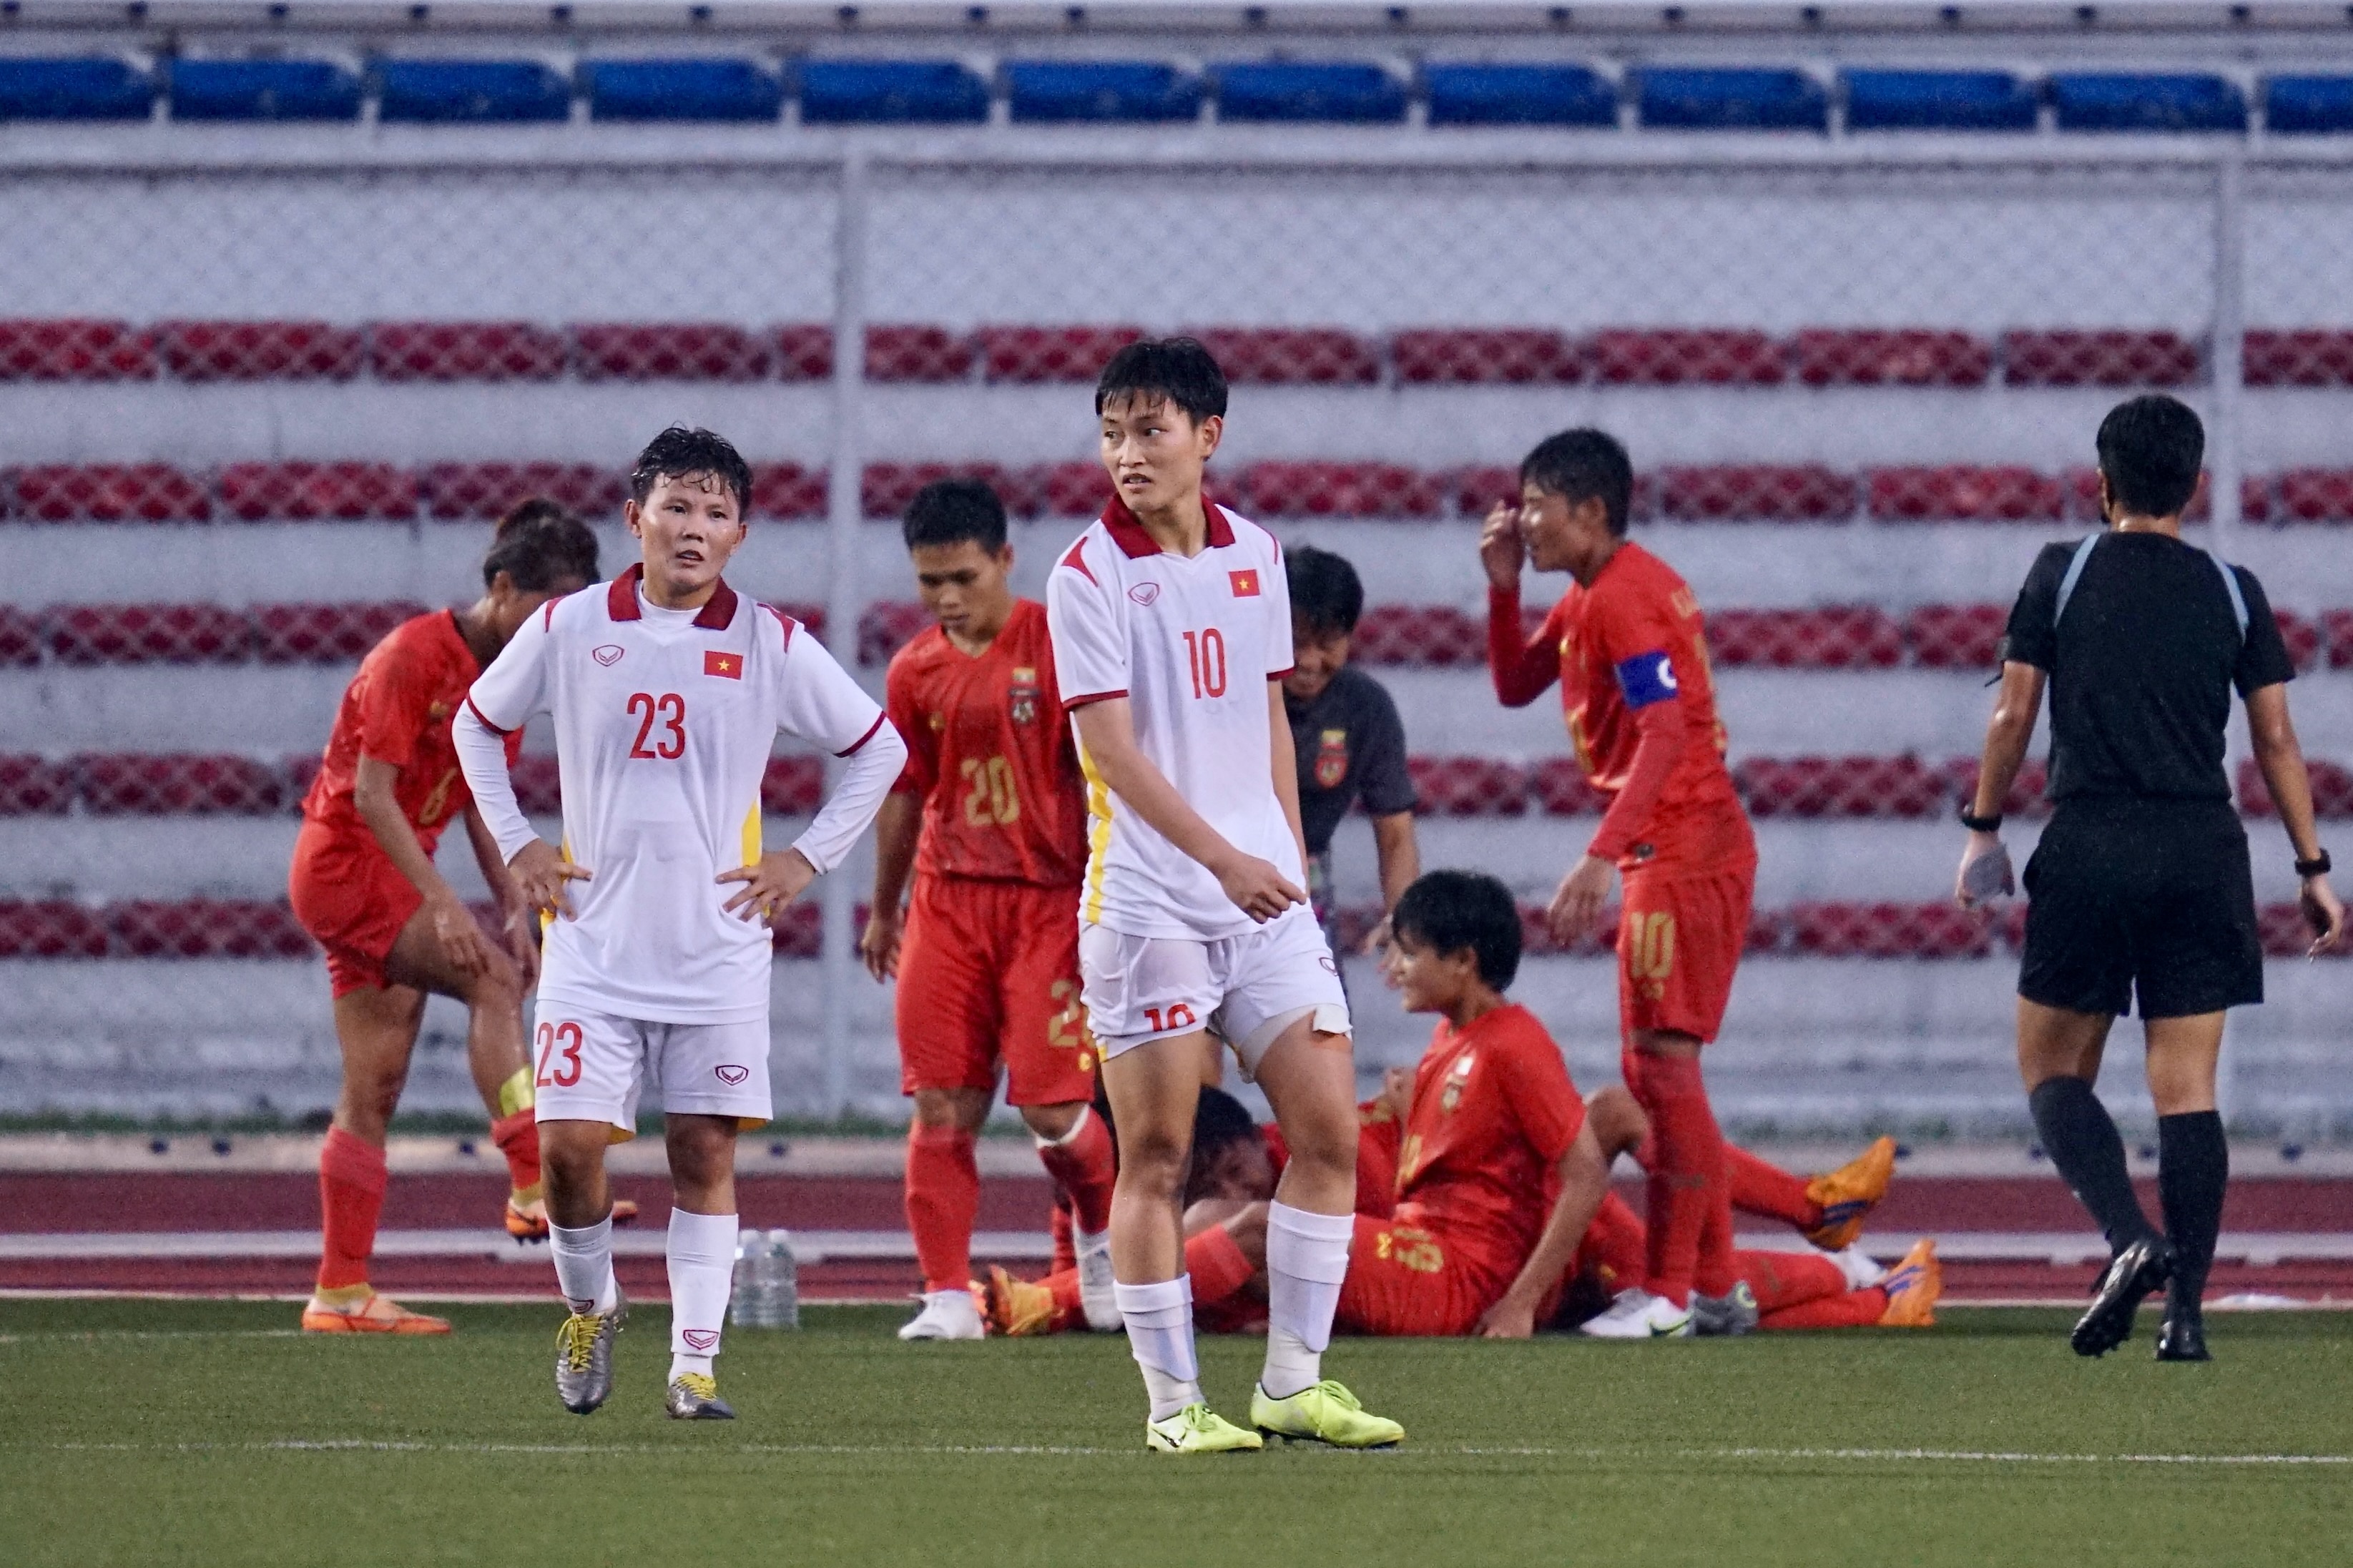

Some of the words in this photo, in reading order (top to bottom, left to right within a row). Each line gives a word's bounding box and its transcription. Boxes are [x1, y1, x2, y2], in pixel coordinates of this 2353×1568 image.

[1182, 628, 1226, 699] 10
[627, 692, 685, 759] 23
[961, 755, 1020, 827] 20
[1631, 912, 1675, 978] 10
[536, 1022, 582, 1088] 23
